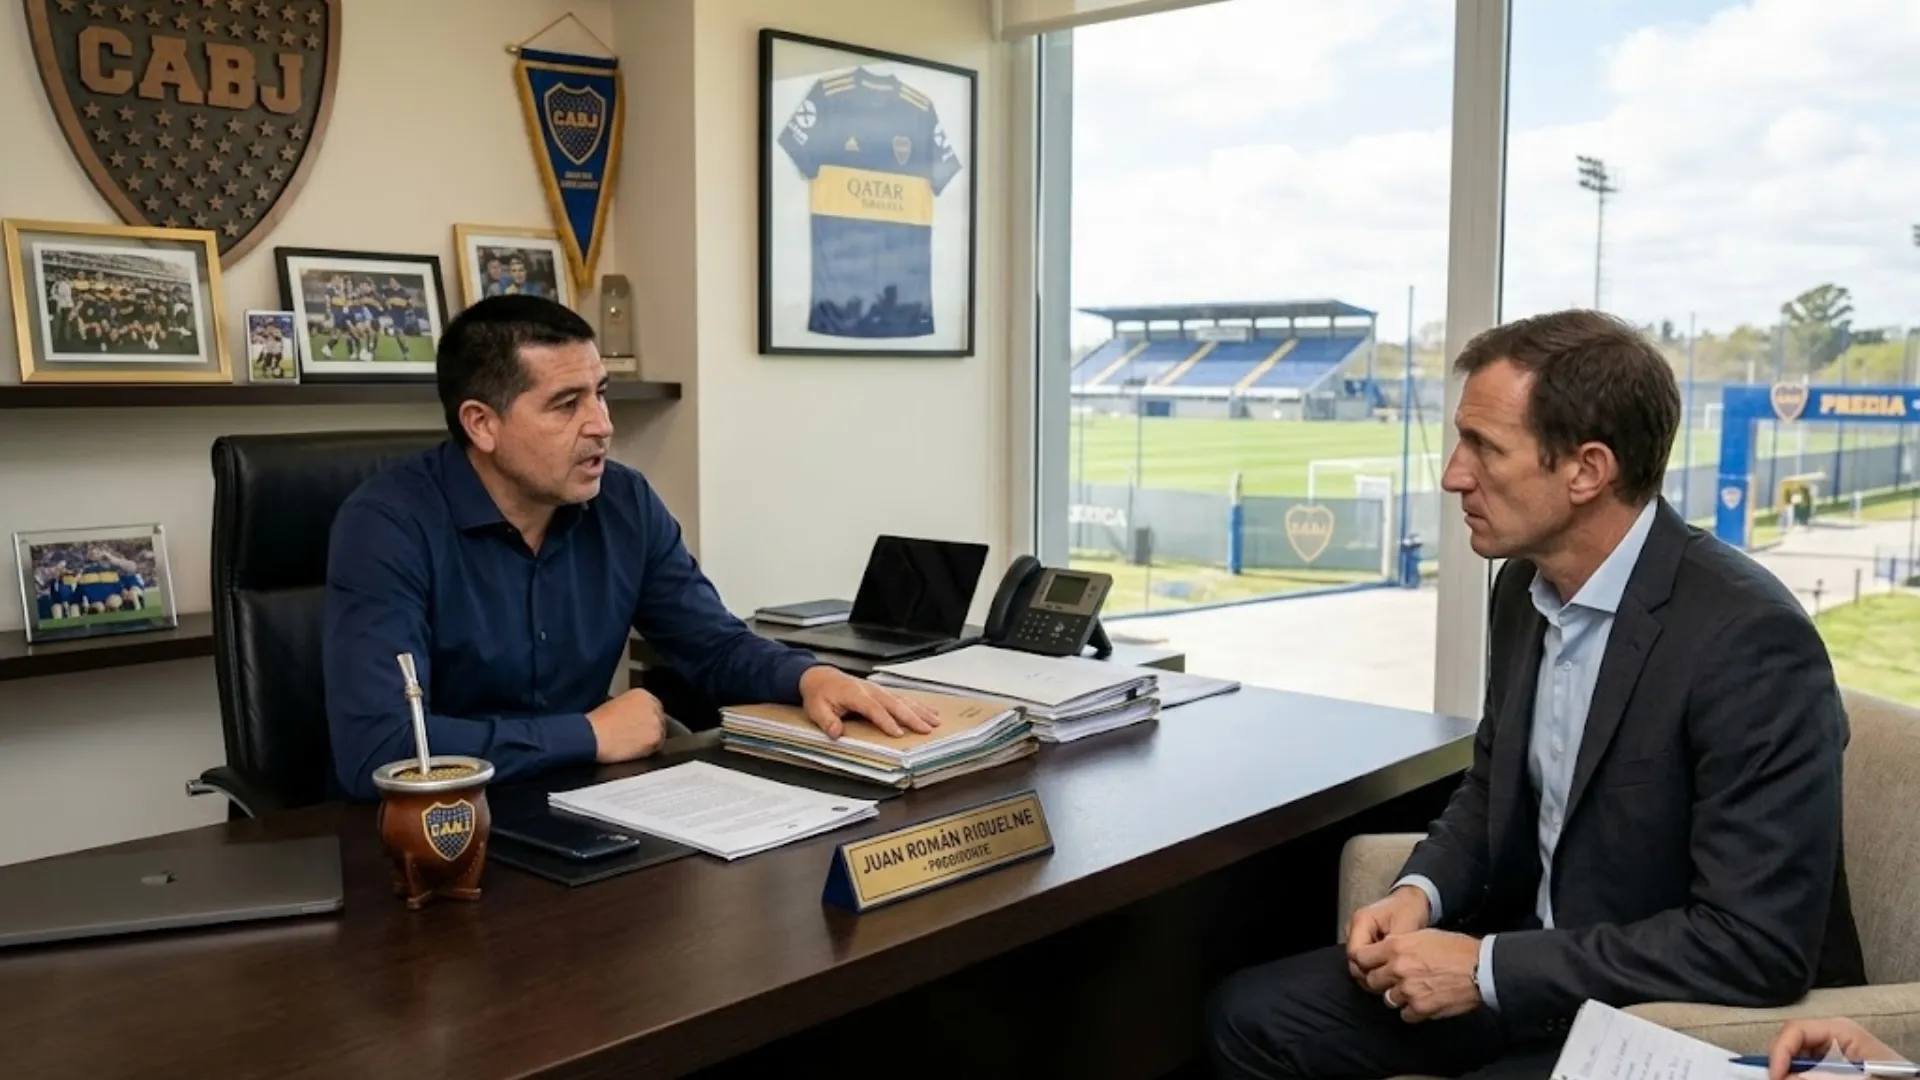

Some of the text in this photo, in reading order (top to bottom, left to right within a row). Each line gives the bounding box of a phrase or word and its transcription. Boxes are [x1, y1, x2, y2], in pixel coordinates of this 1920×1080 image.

[79, 25, 303, 114] CABJ
[846, 177, 905, 201] QATAR
[863, 848, 905, 875] JUAN
